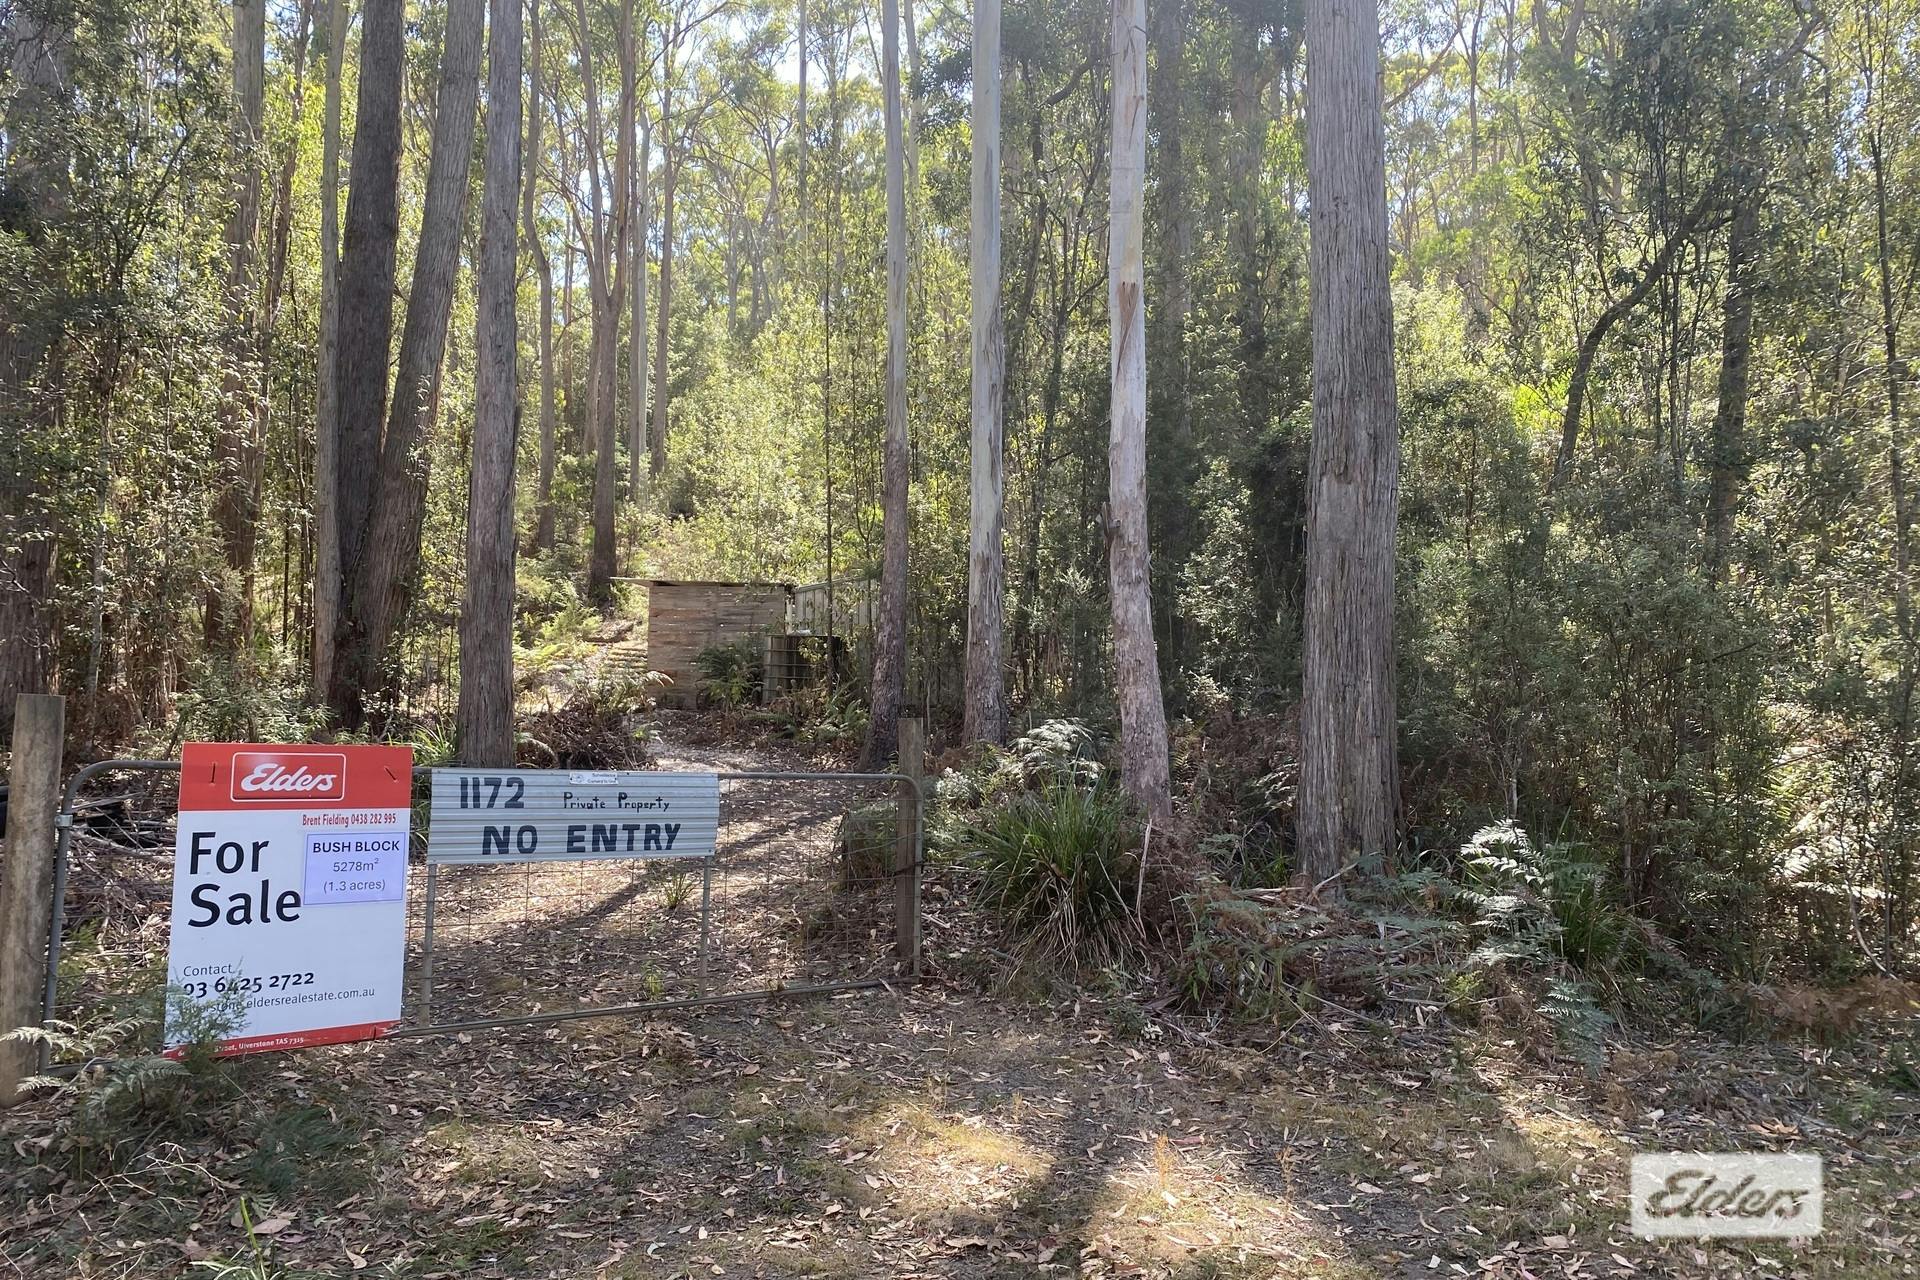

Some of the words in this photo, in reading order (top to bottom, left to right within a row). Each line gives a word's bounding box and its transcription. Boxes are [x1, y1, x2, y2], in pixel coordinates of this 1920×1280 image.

[241, 762, 338, 792] Elders
[459, 776, 525, 809] 1172
[564, 791, 606, 809] Private
[617, 791, 670, 813] Property
[302, 814, 321, 826] Brent
[322, 813, 349, 828] Fielding
[351, 813, 368, 824] 0438
[369, 813, 382, 824] 282
[384, 813, 397, 824] 995
[312, 841, 351, 853] BUSH
[355, 840, 400, 852] BLOCK
[481, 824, 538, 855] NO
[566, 822, 681, 854] ENTRY
[189, 831, 270, 875] For
[323, 880, 347, 894] (1.3
[349, 879, 386, 891] acres)
[187, 879, 302, 928] Sale
[183, 963, 233, 977] Contact
[183, 981, 208, 999] 03
[269, 971, 314, 990] 2722
[275, 1036, 288, 1046] TAS
